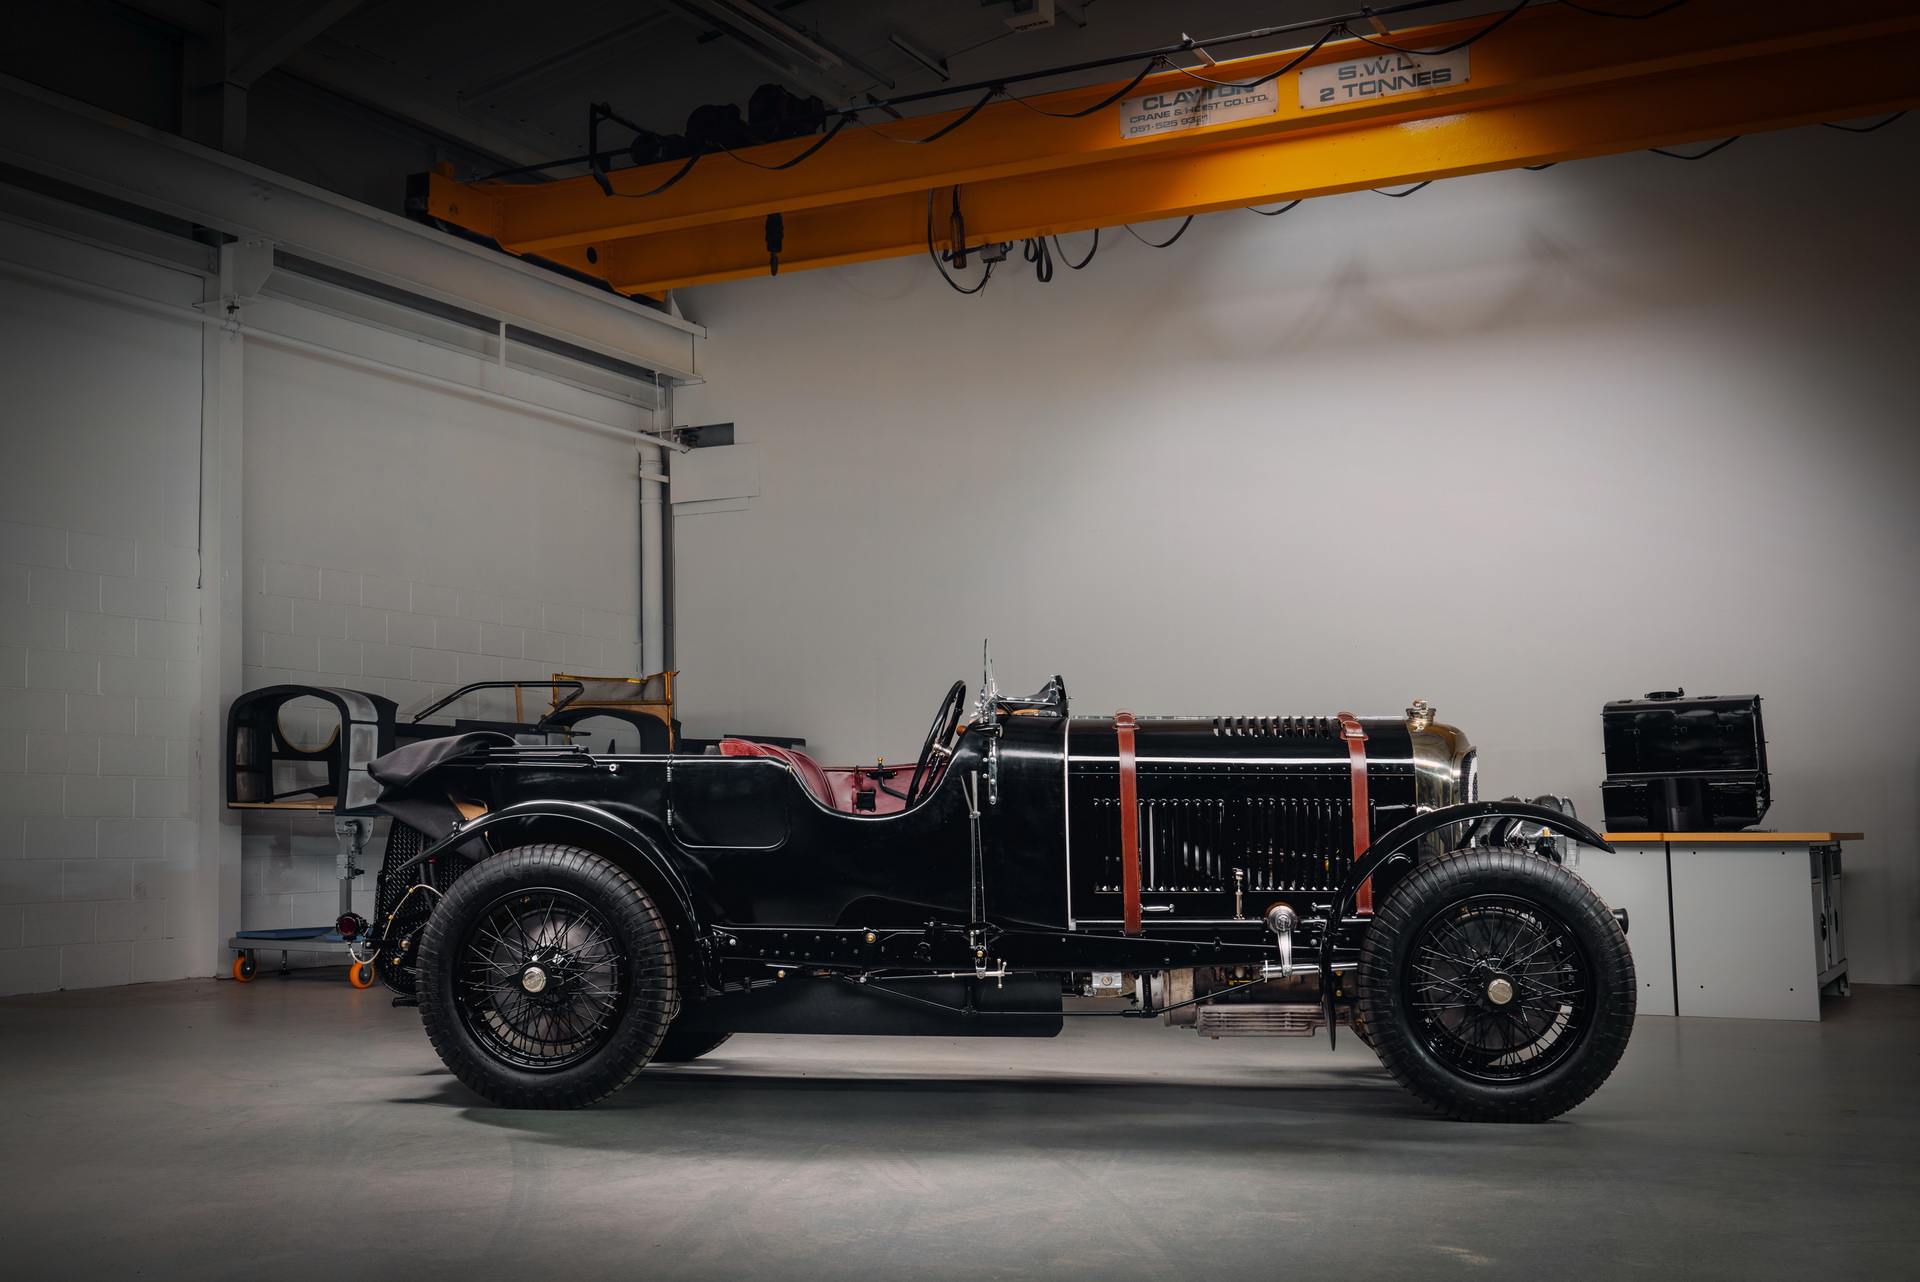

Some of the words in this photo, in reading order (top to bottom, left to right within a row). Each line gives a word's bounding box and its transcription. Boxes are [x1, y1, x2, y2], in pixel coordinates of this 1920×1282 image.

[1338, 58, 1421, 81] S.W.L.
[1319, 87, 1335, 102] 2
[1342, 68, 1452, 98] TONNES
[1129, 110, 1171, 124] CRANE
[1174, 107, 1183, 116] &
[1185, 101, 1221, 114] HOIST
[1223, 98, 1244, 108] CO.
[1245, 94, 1269, 105] LTD.
